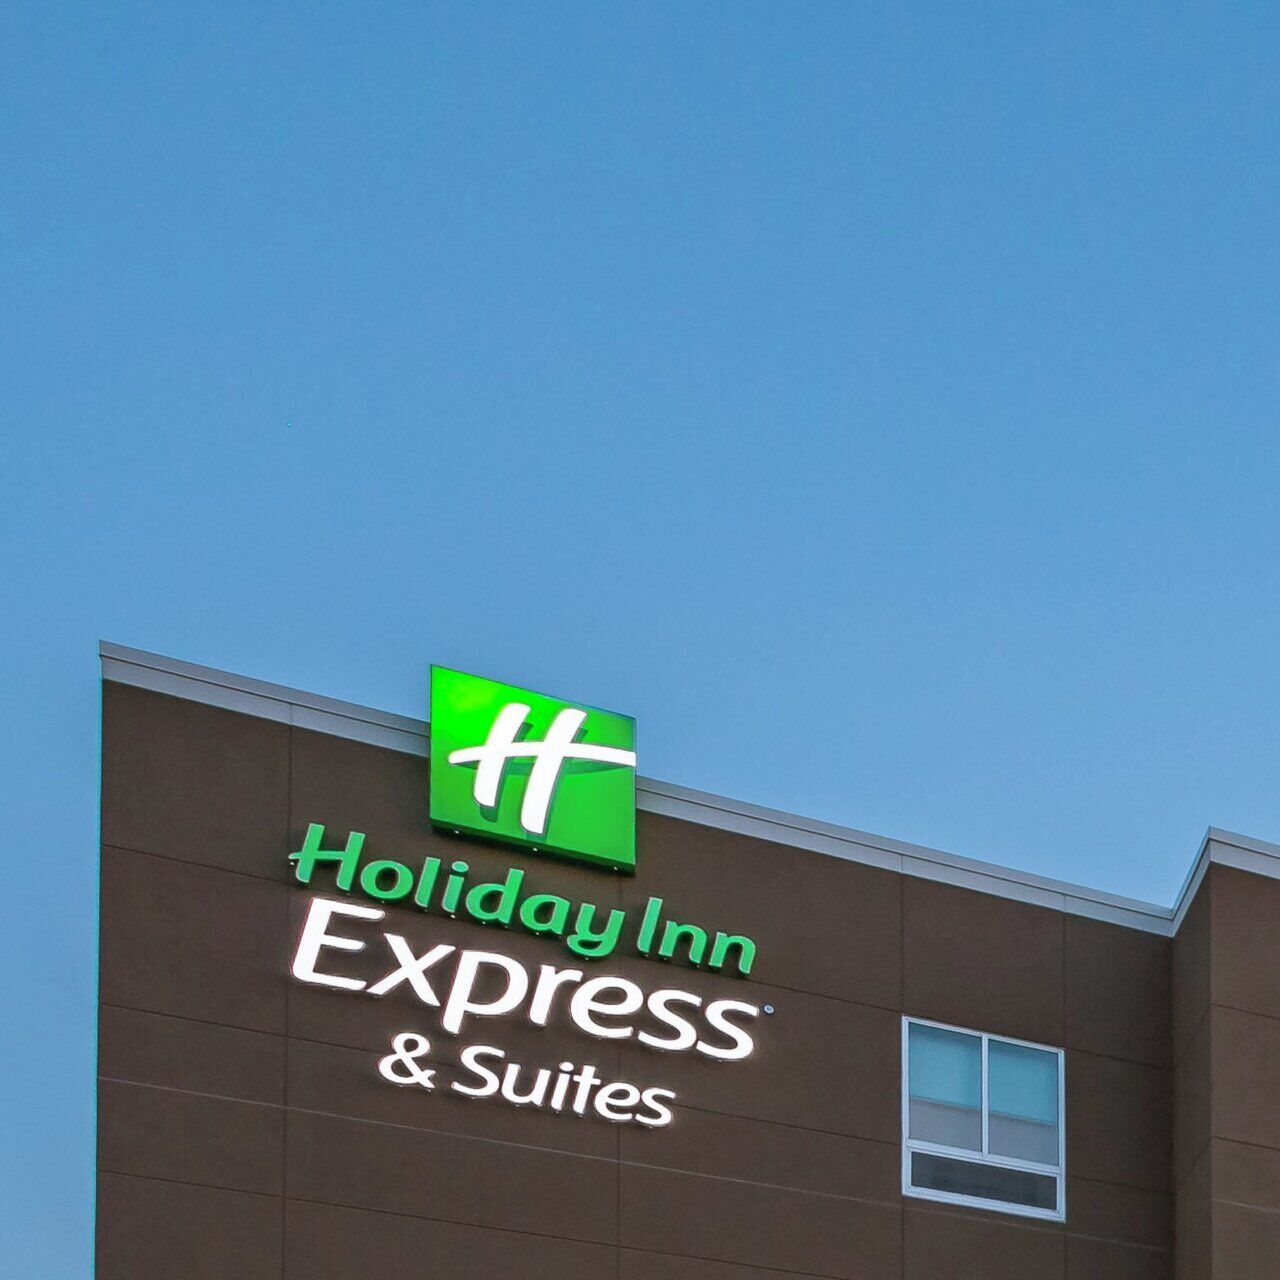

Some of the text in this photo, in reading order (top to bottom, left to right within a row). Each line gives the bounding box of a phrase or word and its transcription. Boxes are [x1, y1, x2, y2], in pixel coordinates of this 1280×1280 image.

[288, 823, 758, 975] Holiday Inn
[291, 896, 762, 1062] Express
[377, 1032, 678, 1127] & Suites
